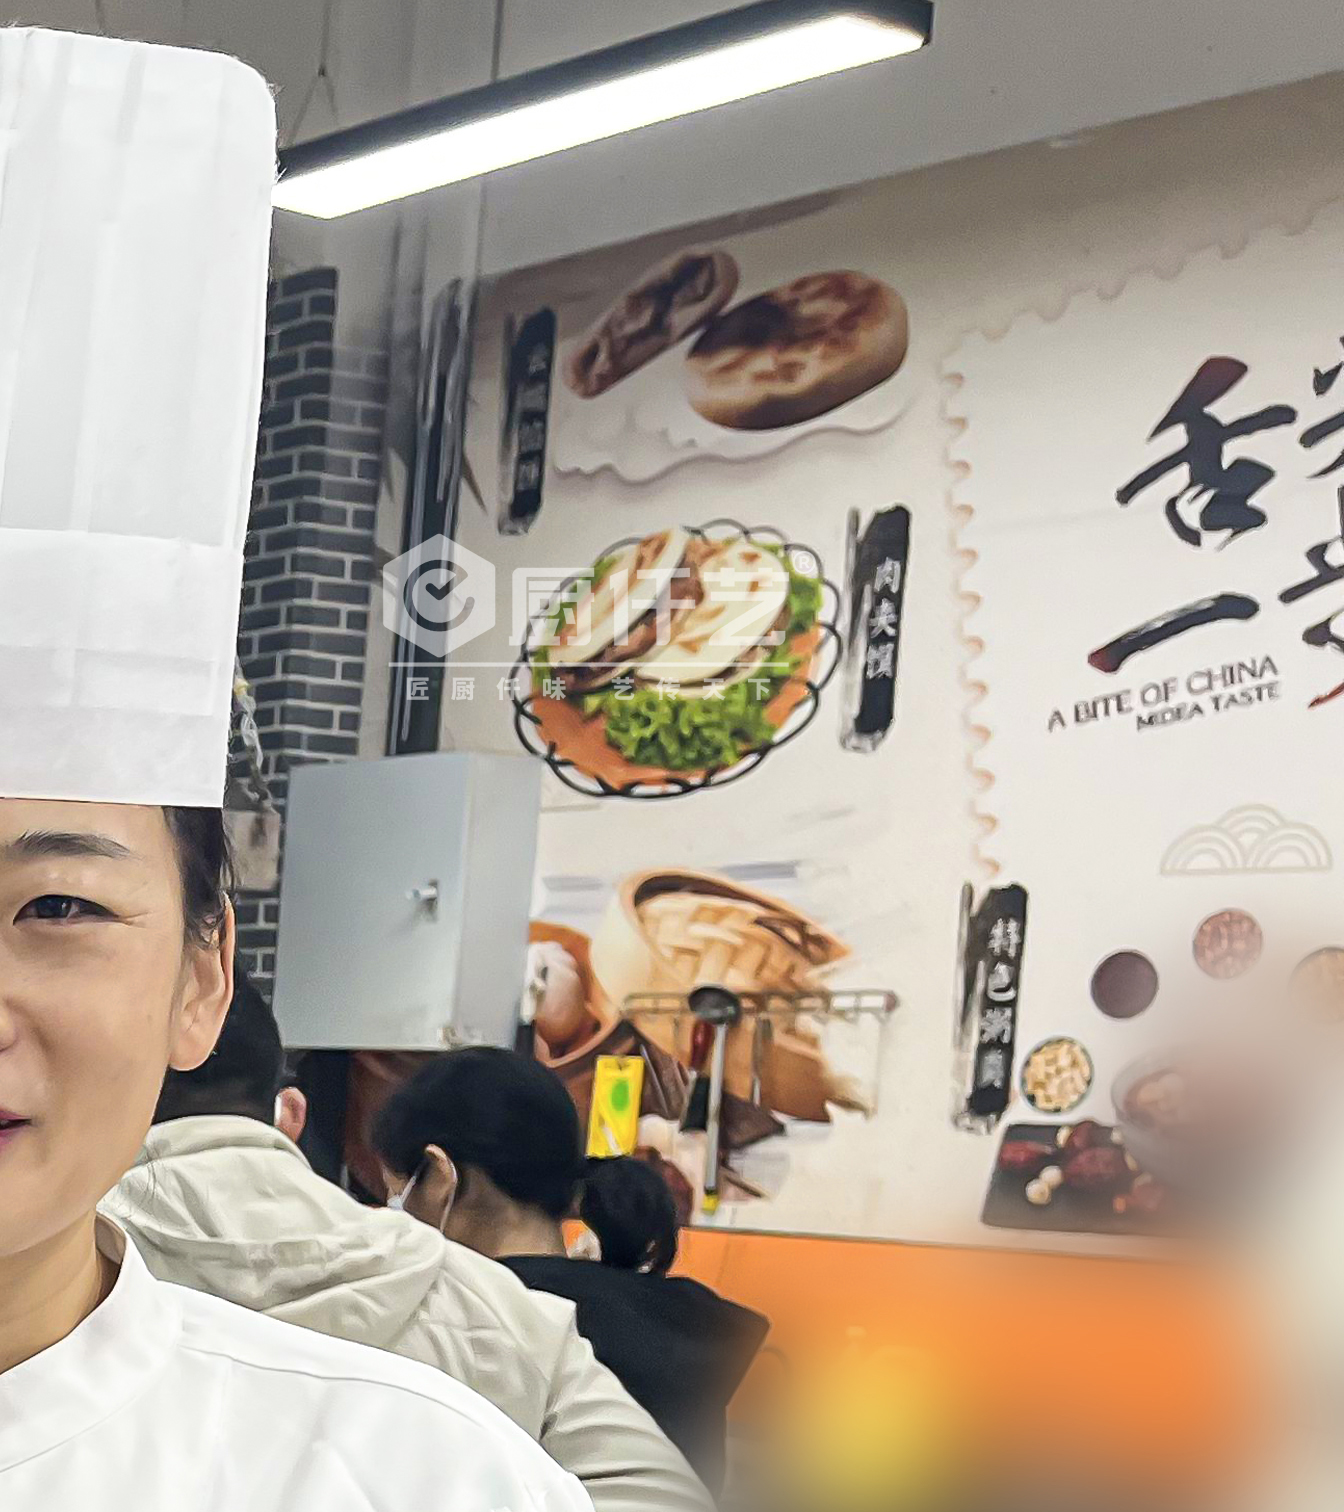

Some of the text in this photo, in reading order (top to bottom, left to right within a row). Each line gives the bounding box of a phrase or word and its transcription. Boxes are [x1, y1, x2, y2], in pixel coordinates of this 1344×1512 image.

[1048, 654, 1279, 733] A BITE OF CHINA
[1210, 680, 1281, 712] TASTE
